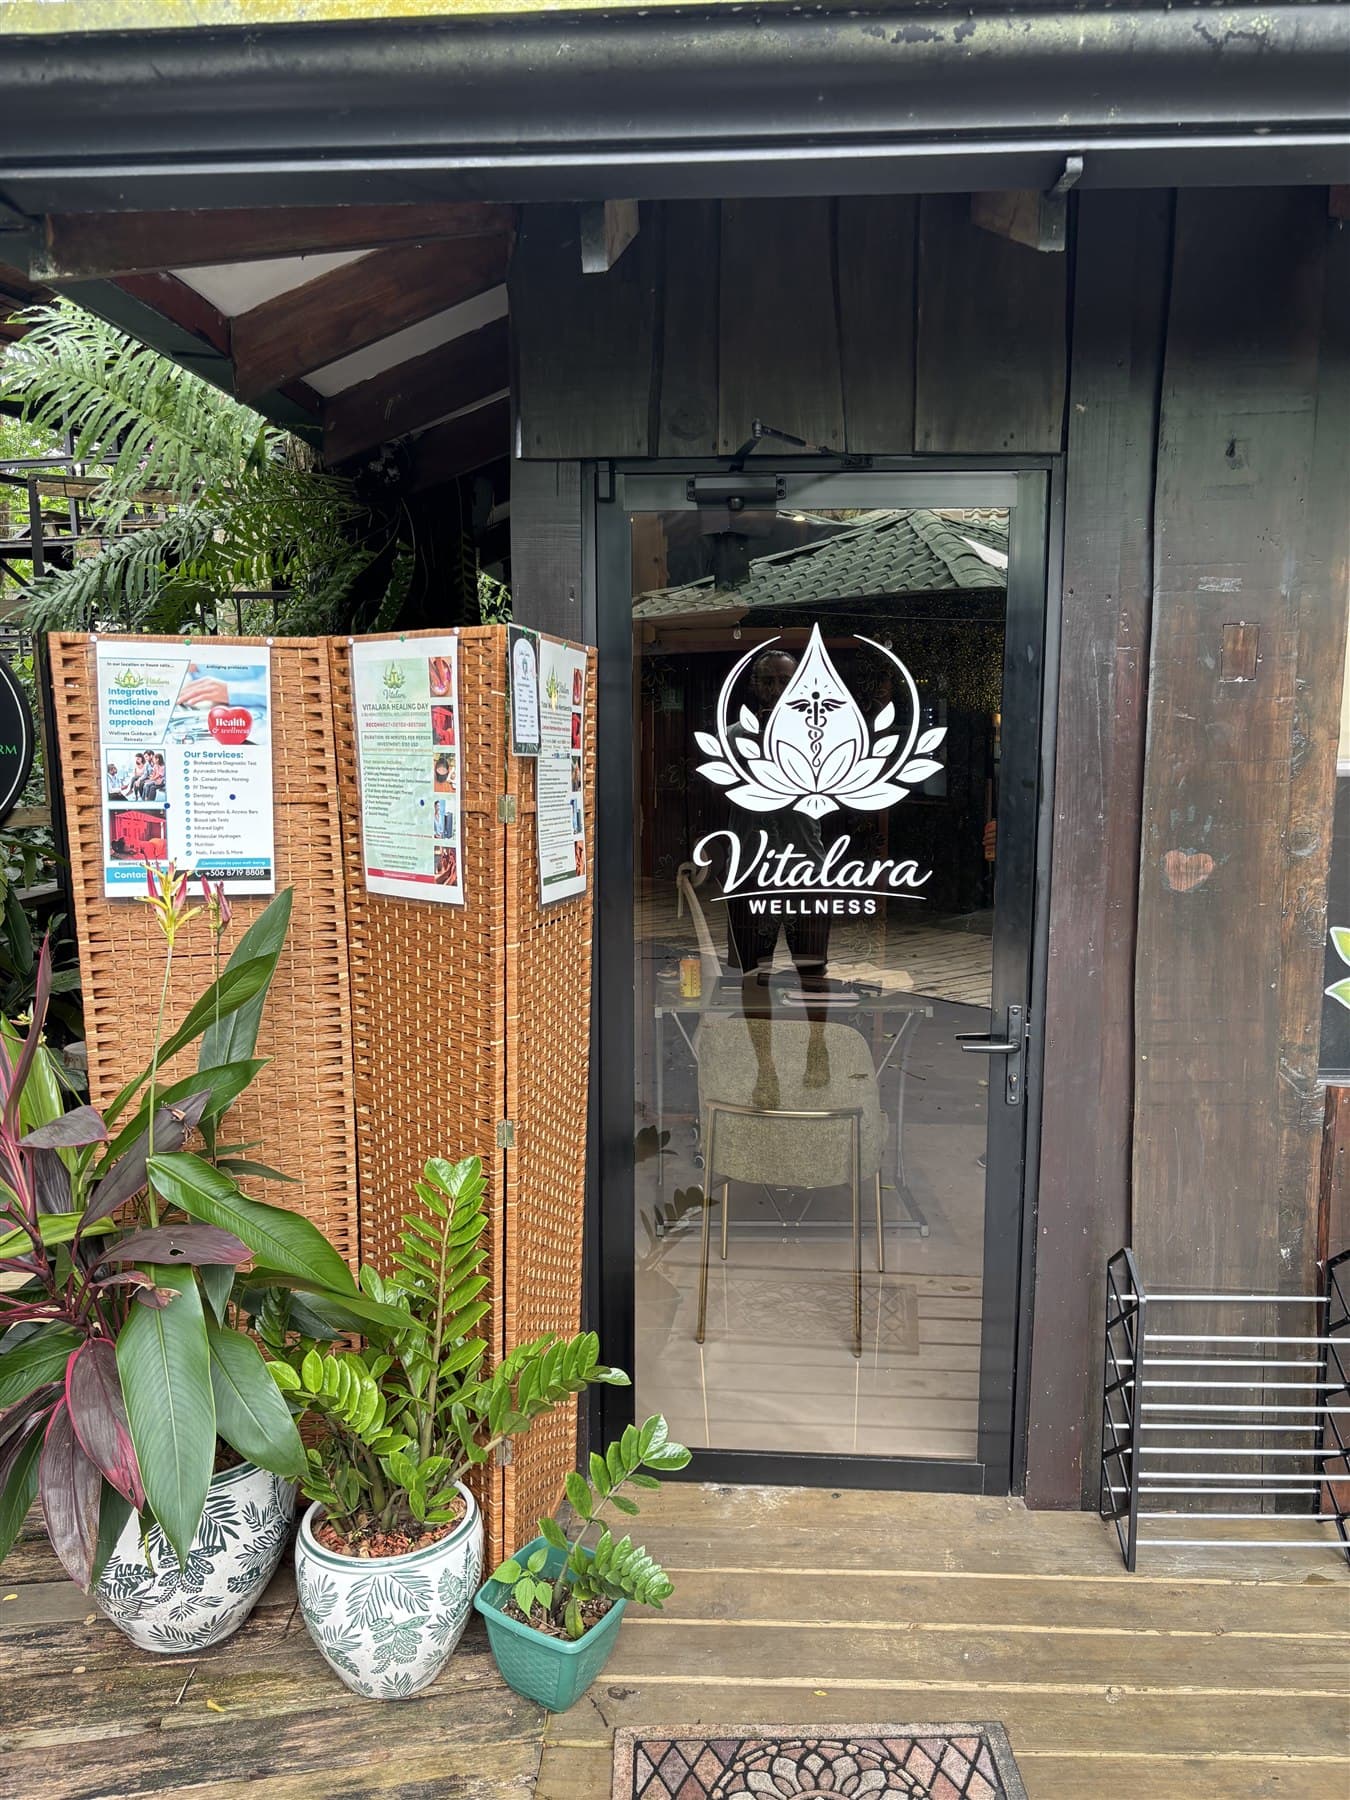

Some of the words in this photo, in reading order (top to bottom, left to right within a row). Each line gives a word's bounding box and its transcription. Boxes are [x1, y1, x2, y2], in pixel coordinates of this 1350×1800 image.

[108, 688, 159, 697] Integrative
[108, 698, 151, 706] medicine
[392, 703, 416, 711] HEALING
[108, 708, 155, 716] functional
[109, 719, 154, 727] approach
[216, 718, 246, 727] Health
[202, 751, 244, 759] Services:
[692, 830, 933, 894] Vitalara
[114, 871, 150, 879] Contac
[749, 900, 877, 915] WELLNESS
